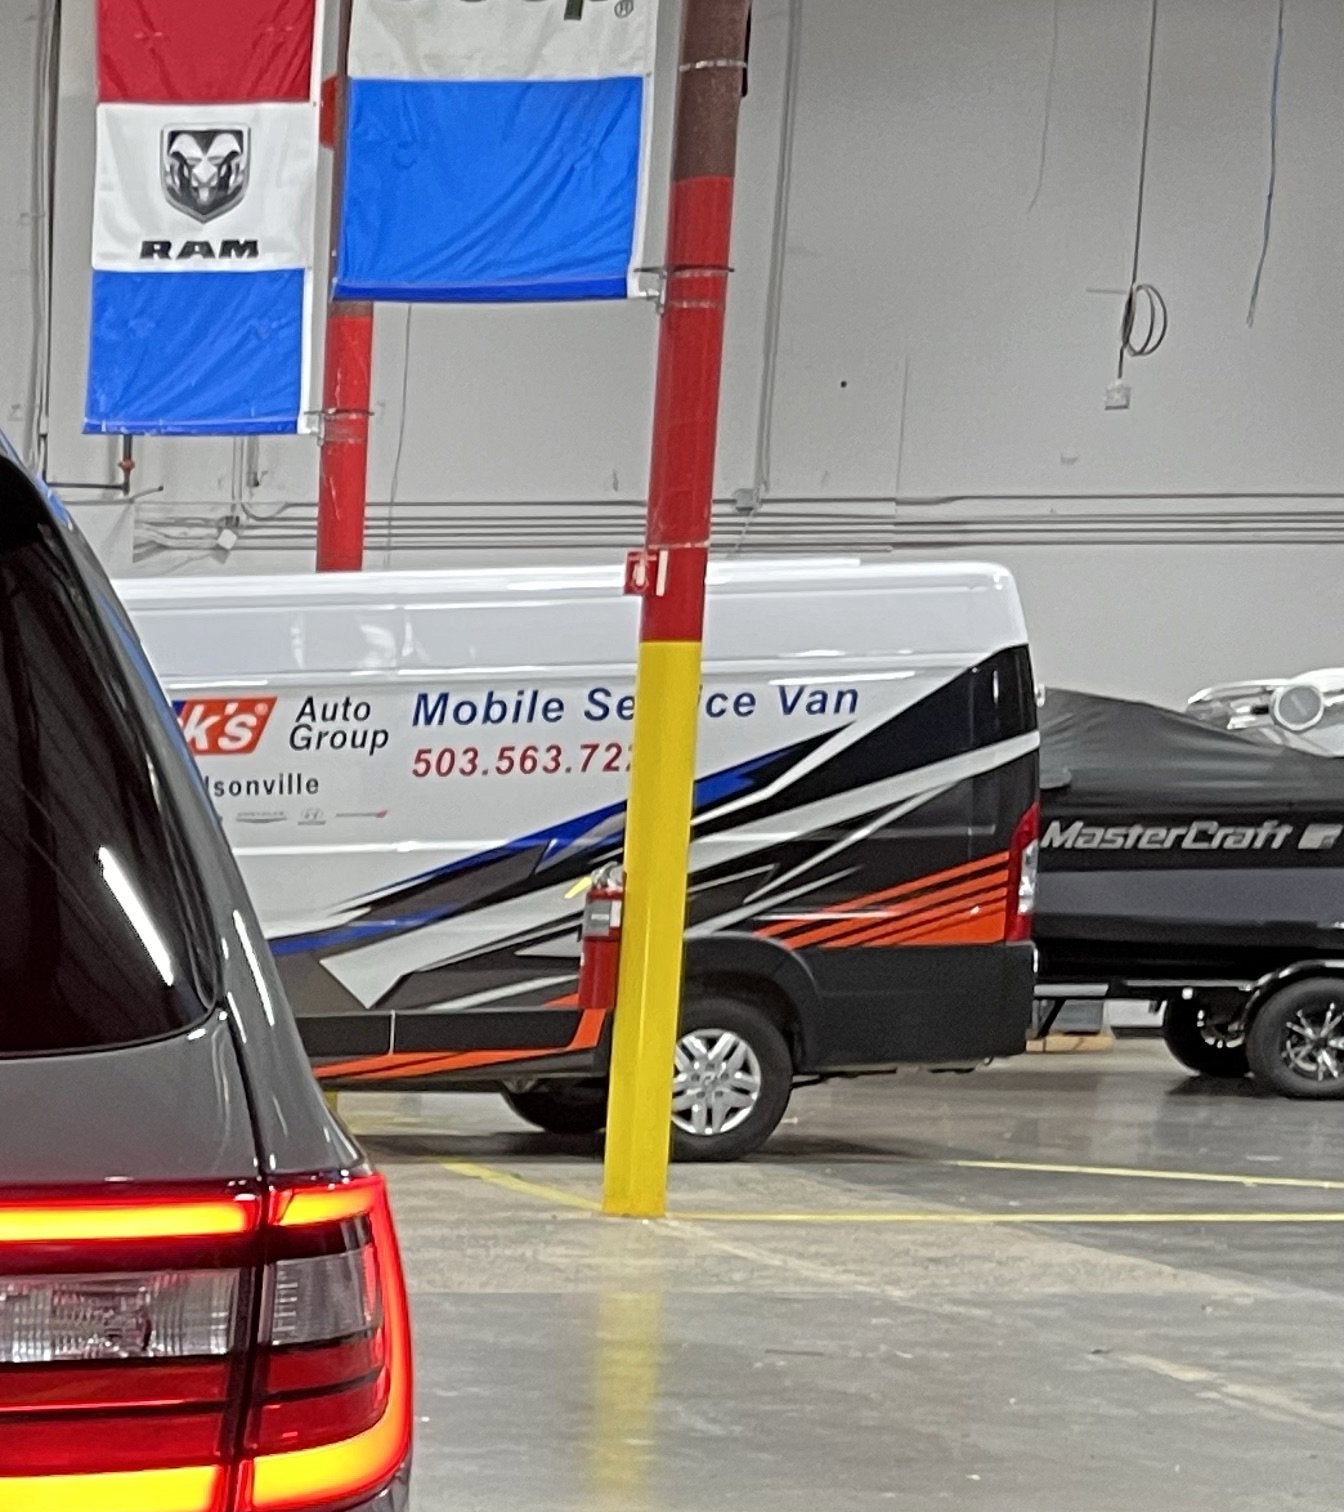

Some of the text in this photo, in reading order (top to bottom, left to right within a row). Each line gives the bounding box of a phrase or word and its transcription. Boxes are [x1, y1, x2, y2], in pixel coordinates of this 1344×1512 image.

[139, 239, 260, 260] RAM
[295, 696, 372, 723] Auto
[412, 684, 859, 727] Mobile Sece Van
[289, 724, 389, 756] Group
[203, 772, 319, 797] lsonville
[1039, 820, 1294, 850] MasterCraft
